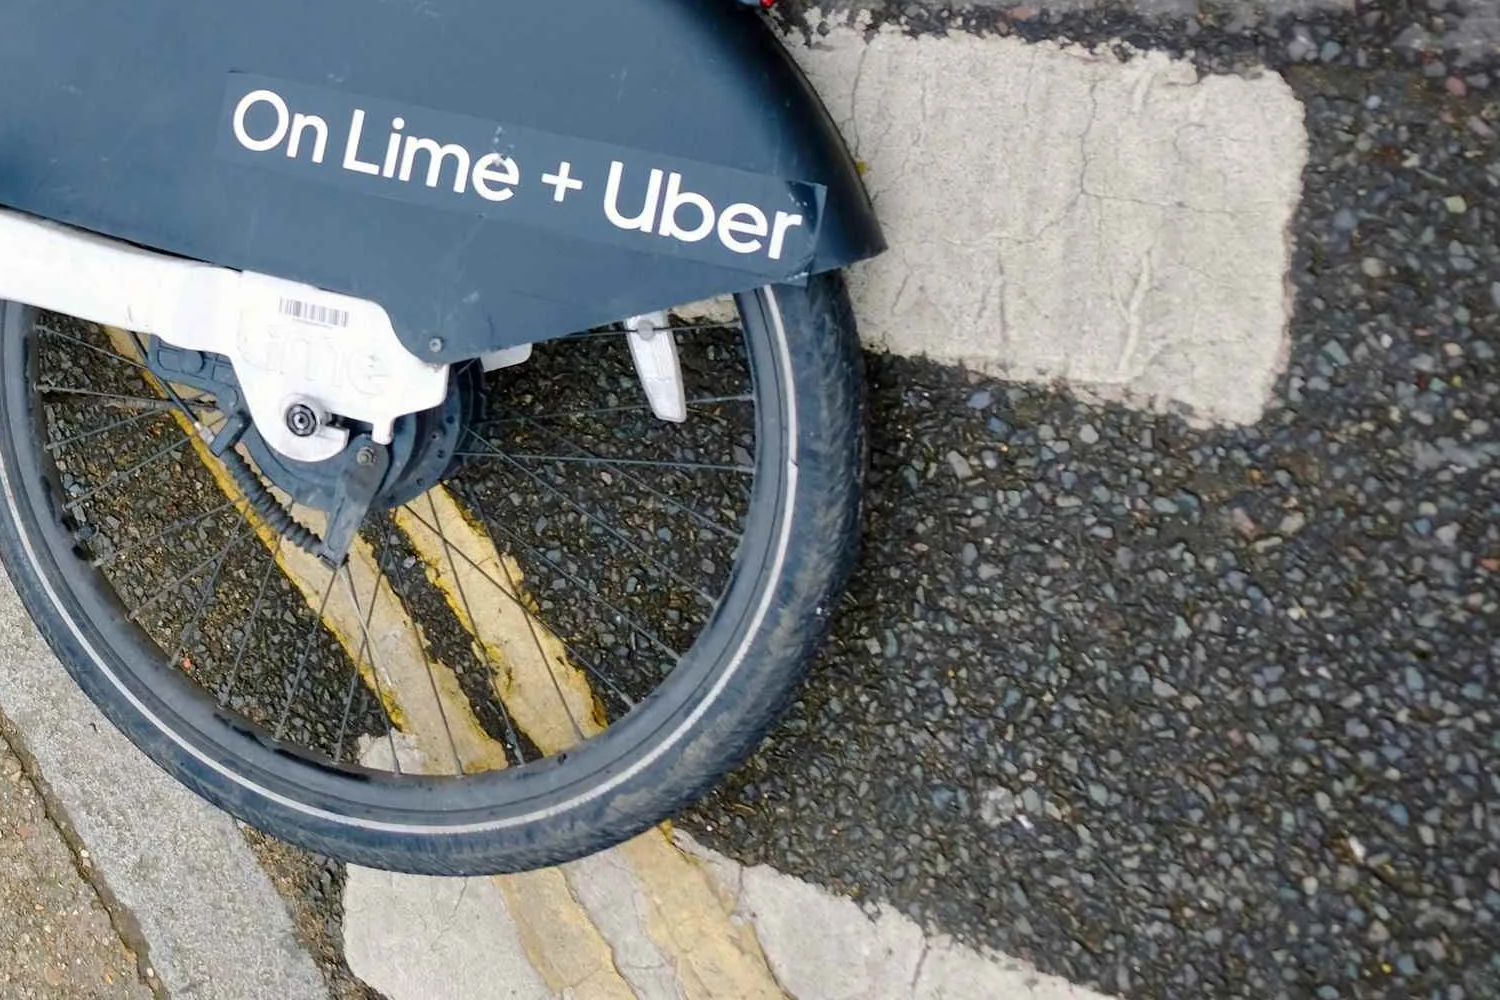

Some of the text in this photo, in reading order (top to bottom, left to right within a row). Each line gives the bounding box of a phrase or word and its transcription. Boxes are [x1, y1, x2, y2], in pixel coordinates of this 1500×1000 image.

[232, 89, 804, 260] On Lime + Uber
